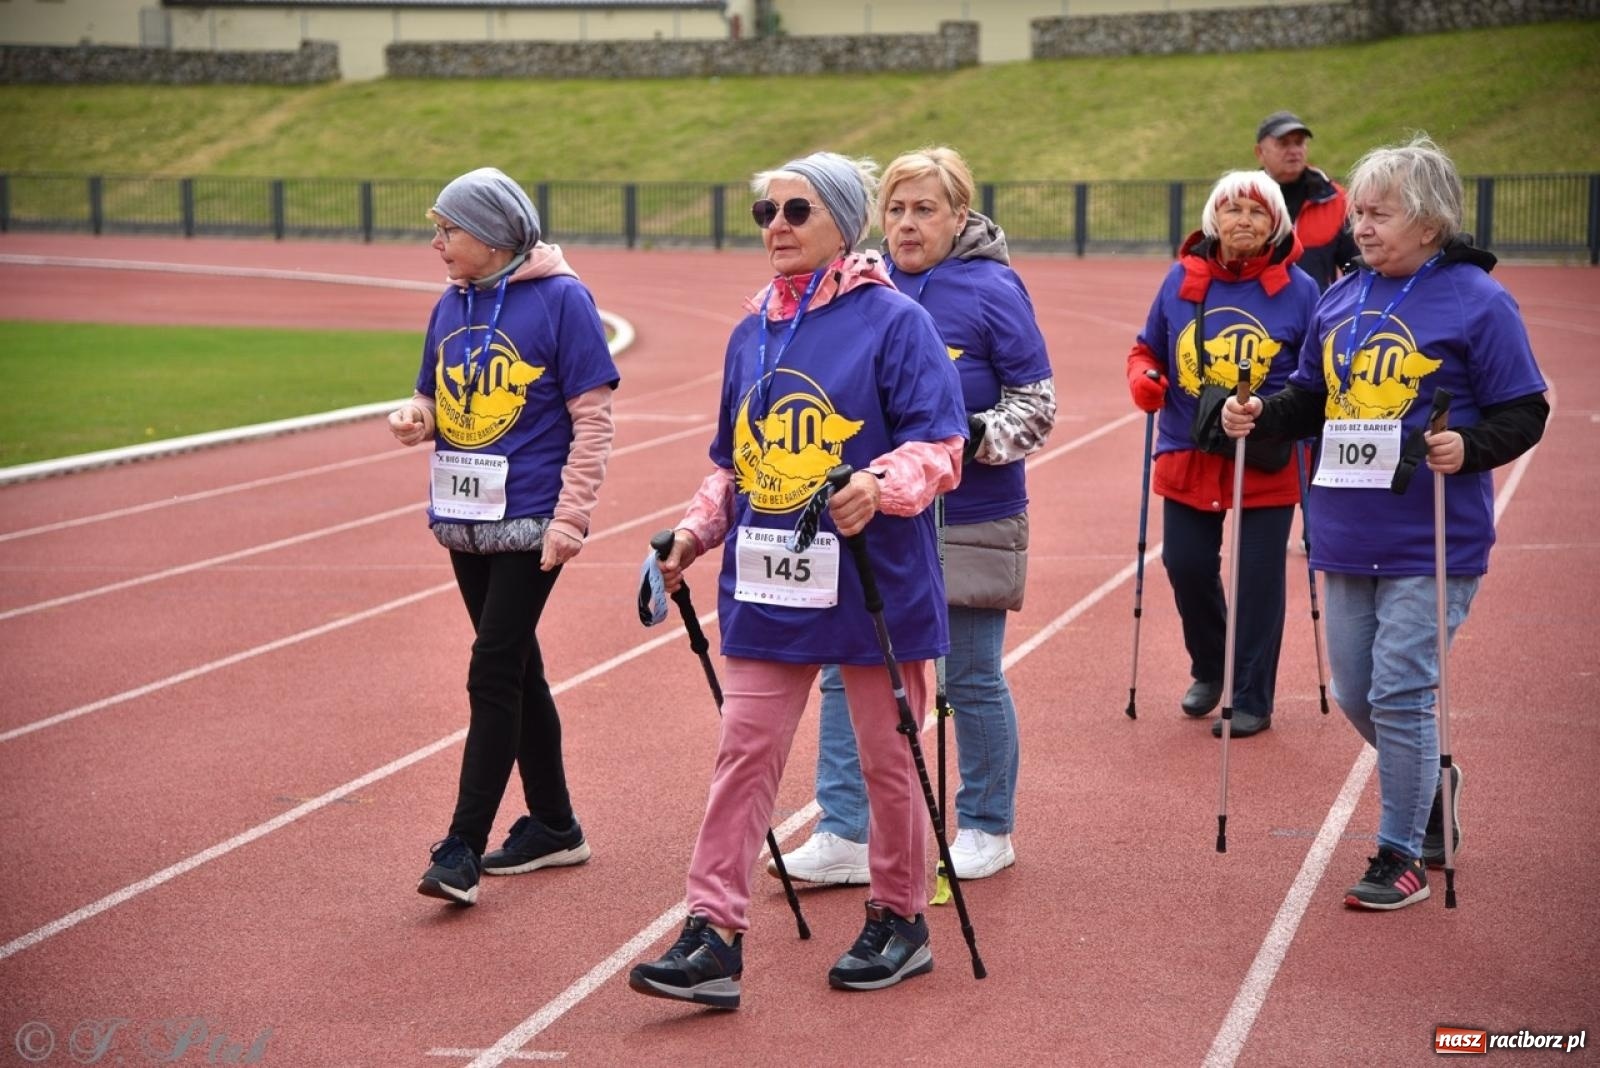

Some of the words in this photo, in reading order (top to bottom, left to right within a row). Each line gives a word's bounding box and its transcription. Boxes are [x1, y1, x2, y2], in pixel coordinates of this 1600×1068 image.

[1225, 333, 1260, 363] 10
[1365, 345, 1405, 385] 10
[779, 407, 823, 454] 10
[1338, 443, 1377, 465] 109
[452, 475, 480, 498] 141
[755, 533, 775, 542] BIEG
[763, 555, 811, 582] 145
